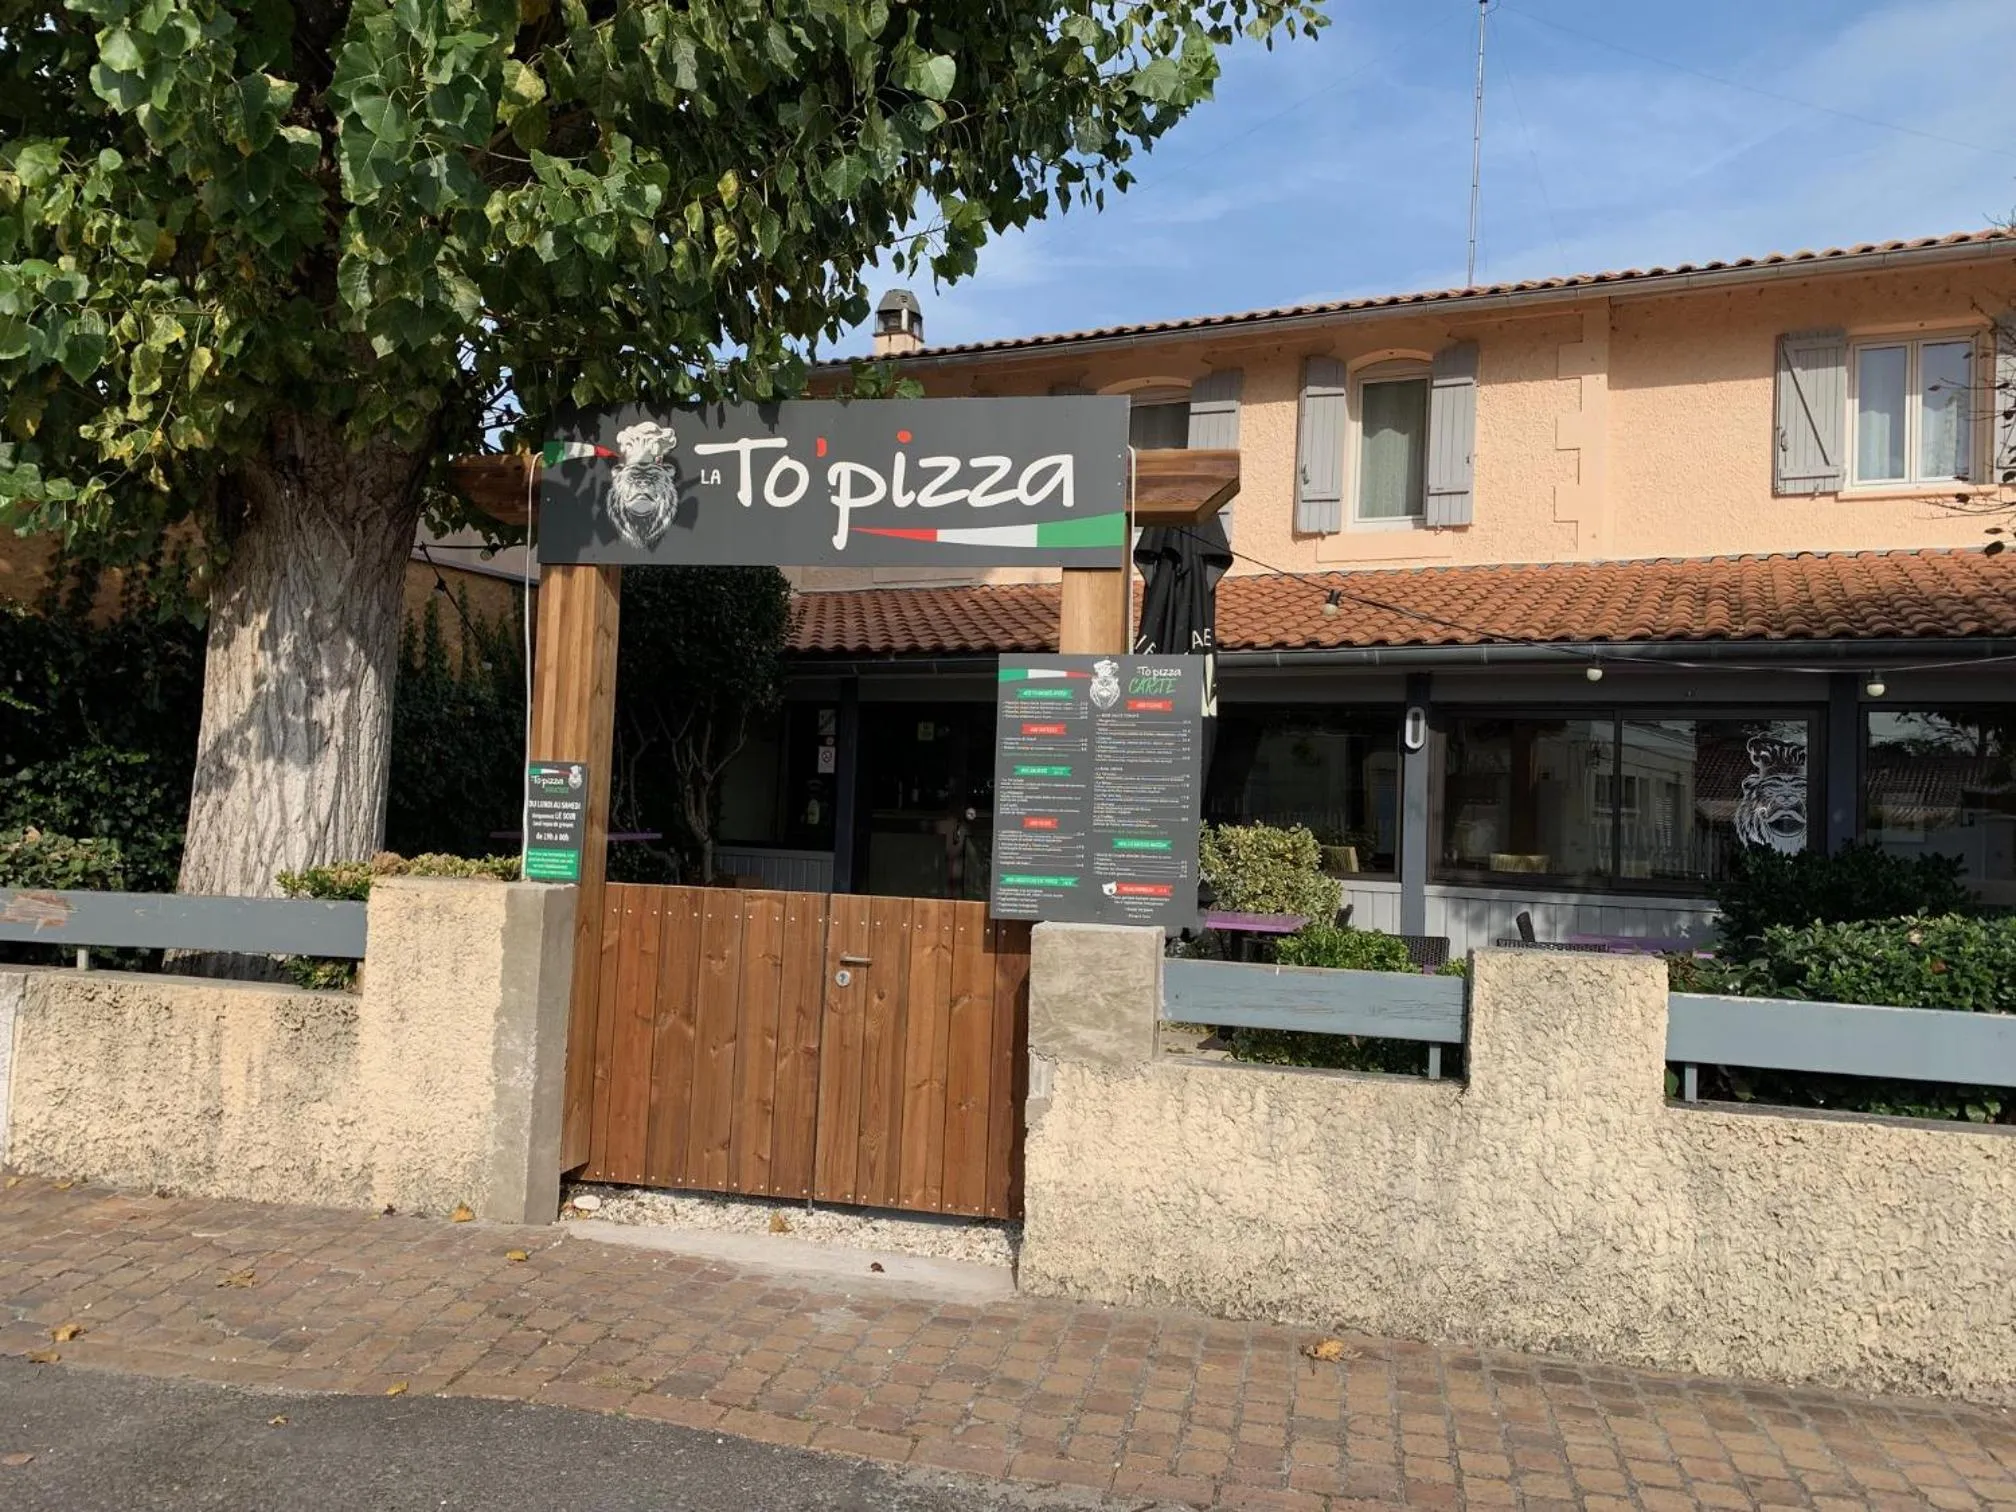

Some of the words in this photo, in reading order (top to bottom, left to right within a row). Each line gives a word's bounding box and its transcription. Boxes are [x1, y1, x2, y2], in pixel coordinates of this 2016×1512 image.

[700, 468, 721, 485] LA
[694, 429, 1075, 551] To'pizza
[1128, 677, 1177, 695] CARTE
